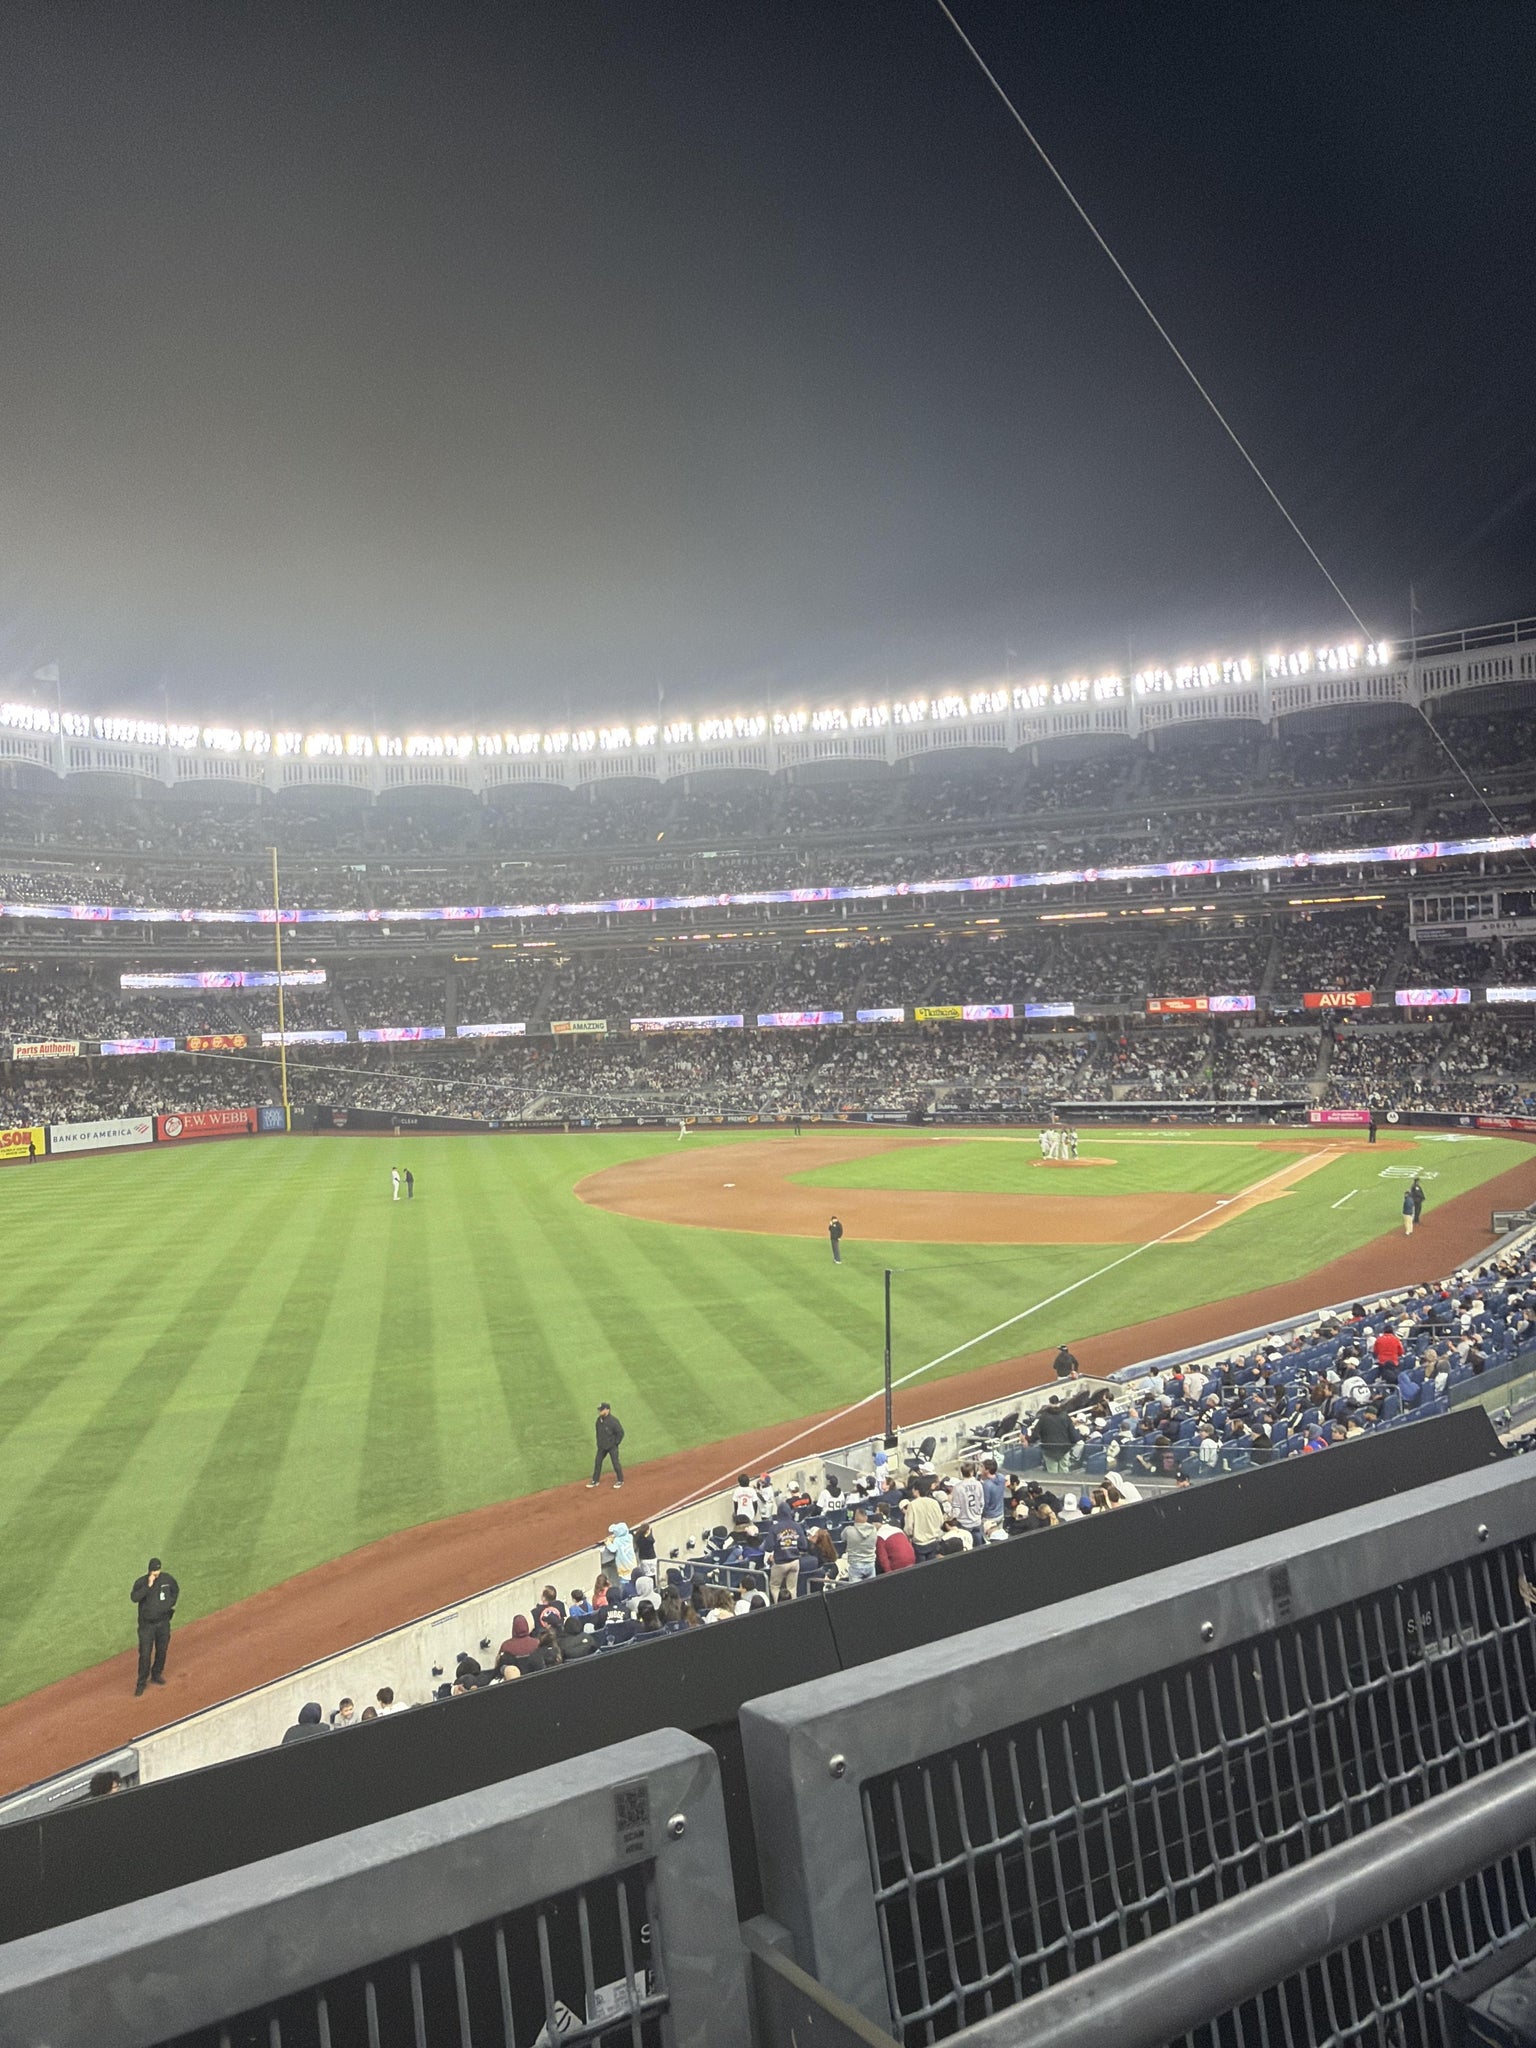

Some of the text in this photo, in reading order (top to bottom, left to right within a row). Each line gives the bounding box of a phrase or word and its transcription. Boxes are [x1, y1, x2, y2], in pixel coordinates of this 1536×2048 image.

[1319, 992, 1357, 1006] AVIS
[572, 1022, 605, 1031] AMAZING
[16, 1043, 76, 1055] Parts Authority
[209, 1111, 248, 1125] WEBB
[53, 1128, 132, 1143] BANK OF AMERICA
[742, 1497, 748, 1506] 2
[968, 1494, 976, 1507] 2
